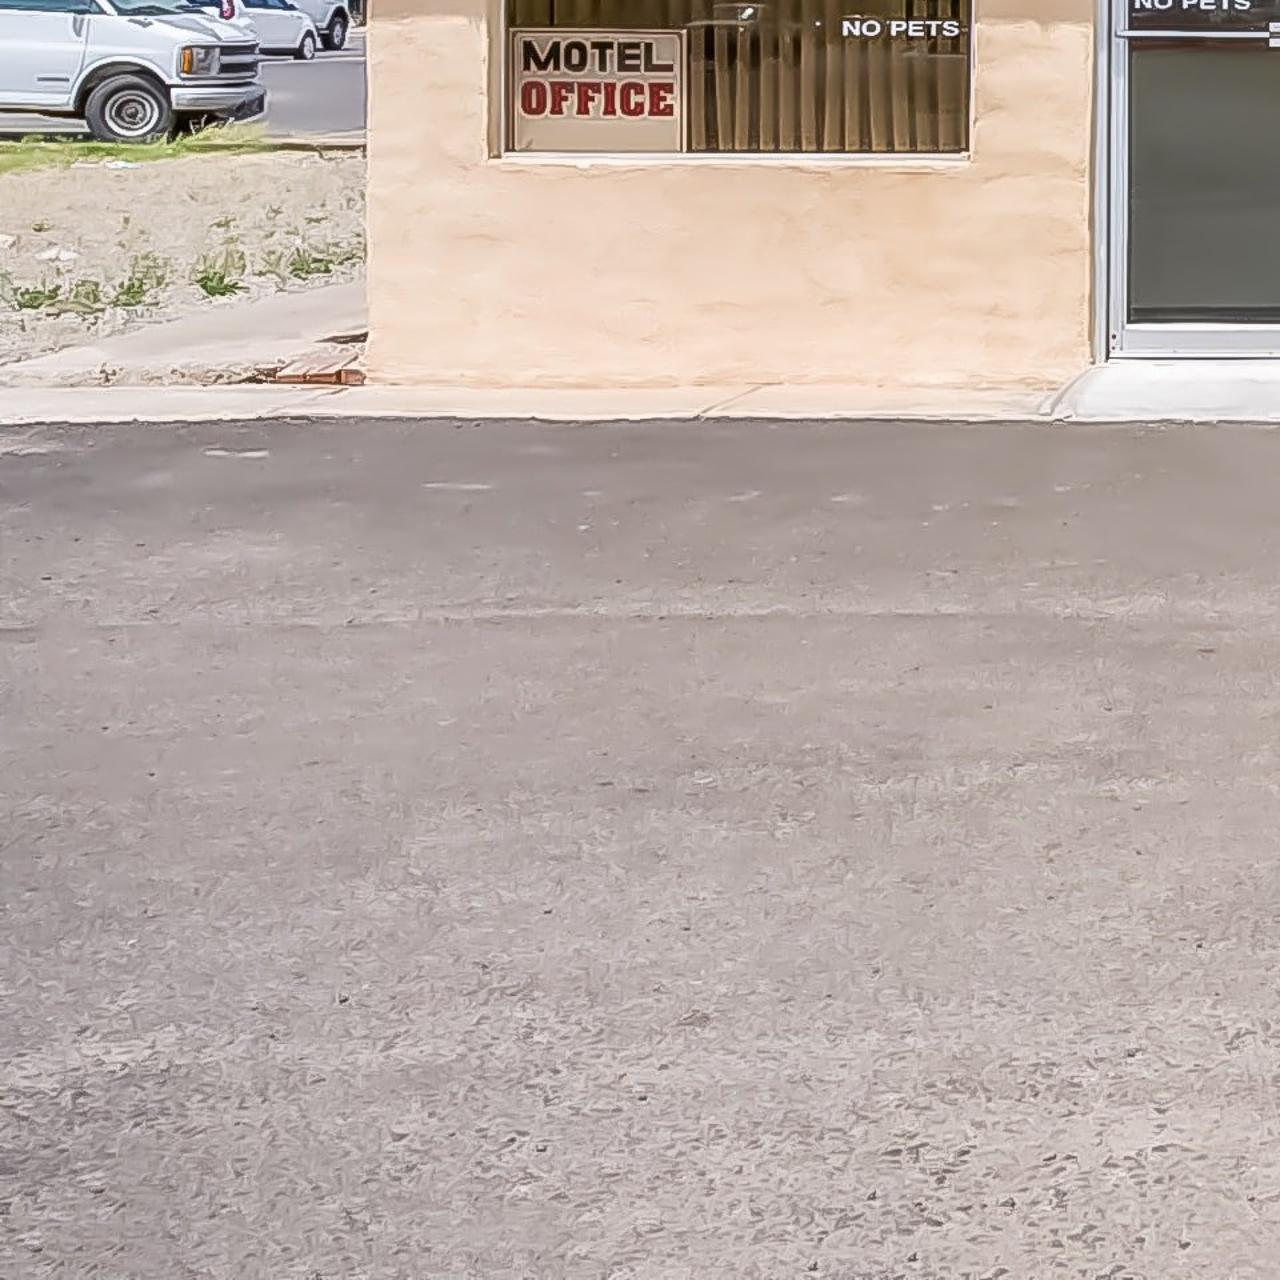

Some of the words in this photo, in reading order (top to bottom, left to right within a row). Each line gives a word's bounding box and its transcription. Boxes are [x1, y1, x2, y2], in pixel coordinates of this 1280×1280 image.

[842, 20, 881, 37] NO
[890, 20, 960, 37] PETS
[522, 40, 674, 72] MOTEL
[520, 81, 674, 117] OFFICE
